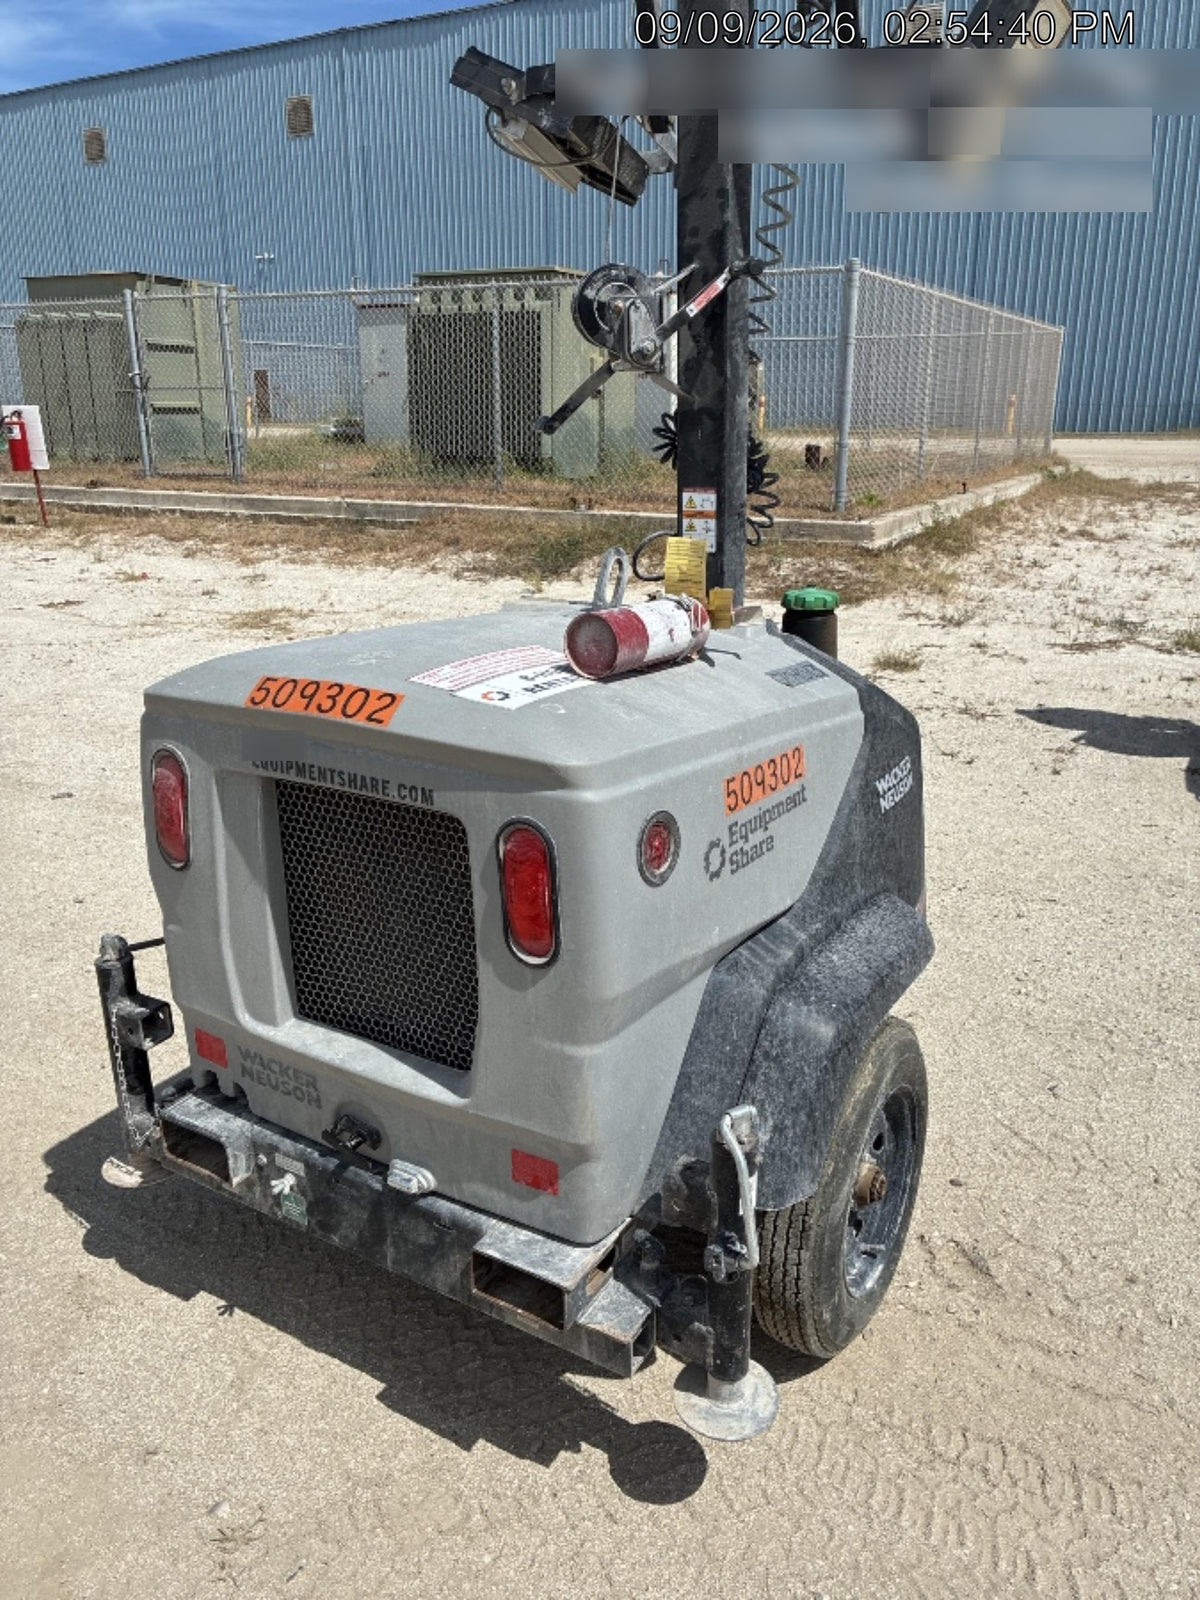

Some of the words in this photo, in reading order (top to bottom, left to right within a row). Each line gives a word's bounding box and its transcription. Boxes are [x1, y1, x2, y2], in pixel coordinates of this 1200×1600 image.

[250, 676, 398, 724] 509302
[726, 747, 804, 813] 509302
[728, 784, 807, 848] Equipment
[729, 835, 775, 875] Share
[237, 1045, 318, 1092] WACKER
[241, 1064, 323, 1110] NEUSON
